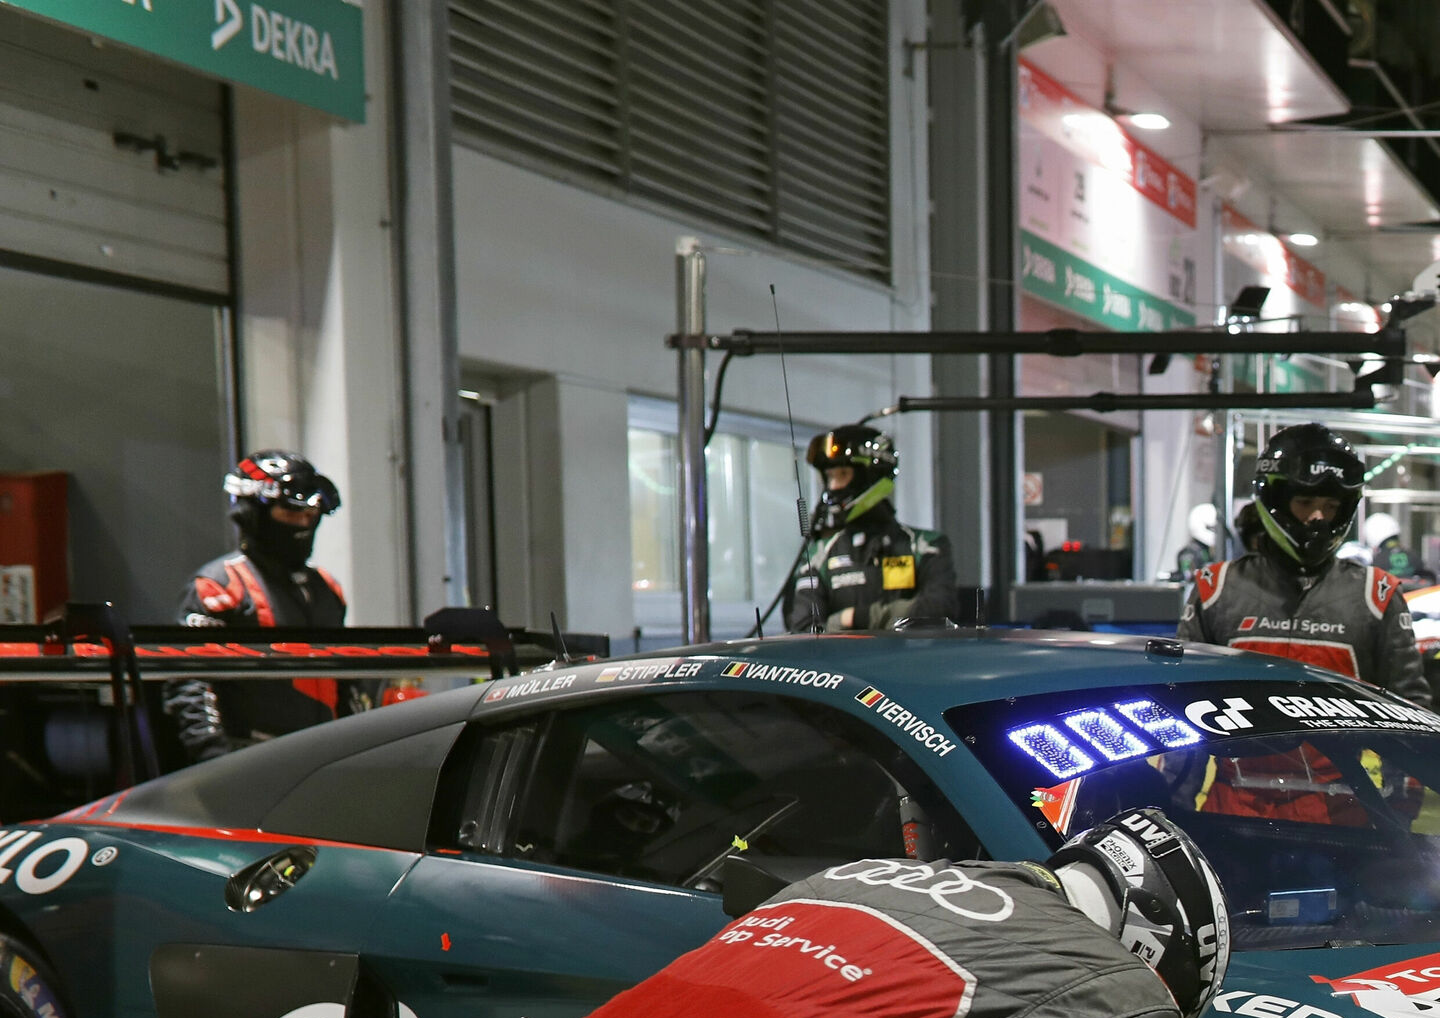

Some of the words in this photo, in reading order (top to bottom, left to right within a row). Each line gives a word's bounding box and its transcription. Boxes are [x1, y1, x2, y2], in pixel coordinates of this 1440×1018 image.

[251, 4, 339, 81] DEKRA
[1258, 616, 1299, 631] Audi
[1301, 619, 1346, 635] Sport
[617, 661, 703, 682] STIPPLER
[743, 663, 844, 691] VANTHOOR
[507, 674, 577, 699] MÜLLER
[1268, 696, 1370, 719] GRAN
[875, 698, 958, 758] VERVISCH
[1300, 719, 1337, 729] THE
[1334, 719, 1379, 729] REAL
[1121, 813, 1176, 848] uv
[718, 930, 754, 944] op
[753, 933, 864, 982] Service
